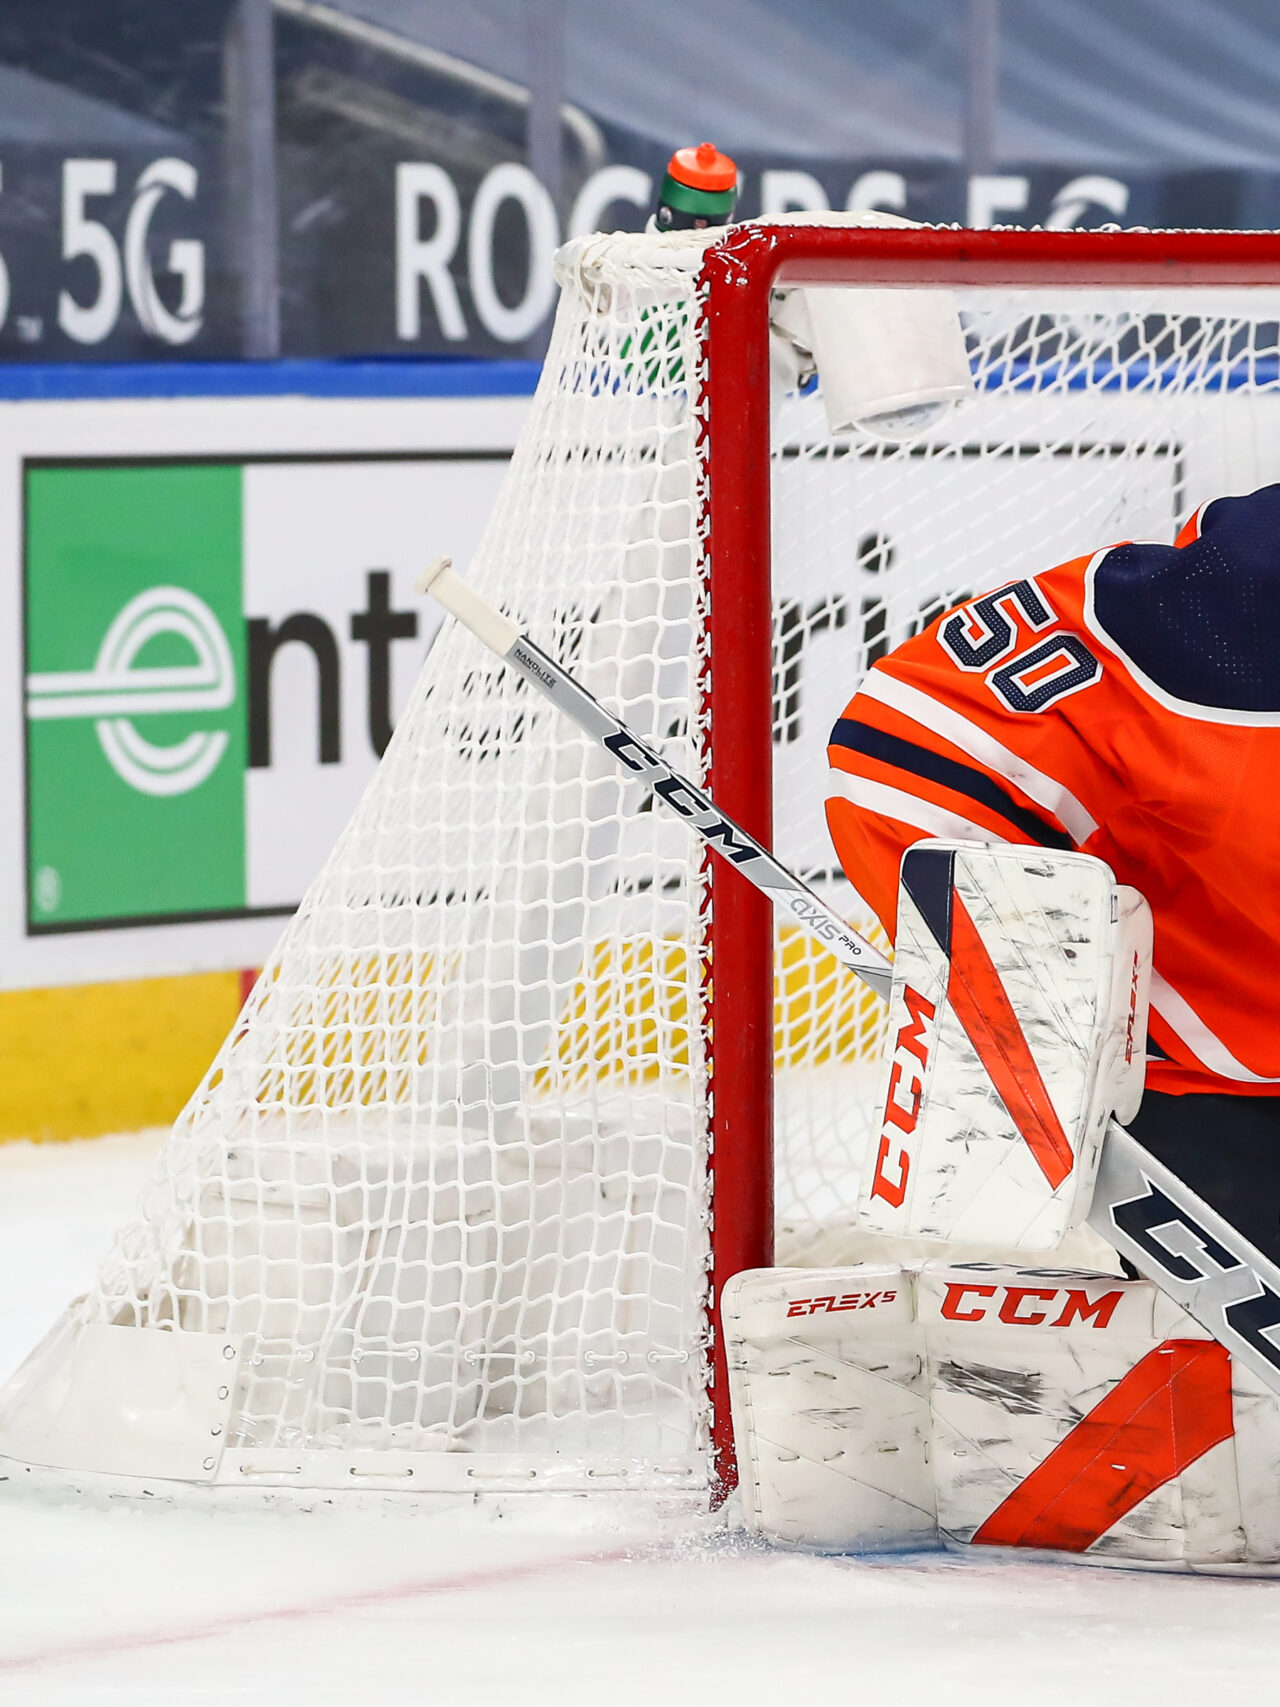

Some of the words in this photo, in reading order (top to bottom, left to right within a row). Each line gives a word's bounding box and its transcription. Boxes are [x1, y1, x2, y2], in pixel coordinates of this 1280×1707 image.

[57, 156, 206, 345] 5G
[936, 576, 1103, 713] 50
[603, 727, 762, 865] CCM
[838, 934, 862, 956] PRO
[870, 984, 936, 1209] CCM
[940, 1282, 1126, 1329] CCM
